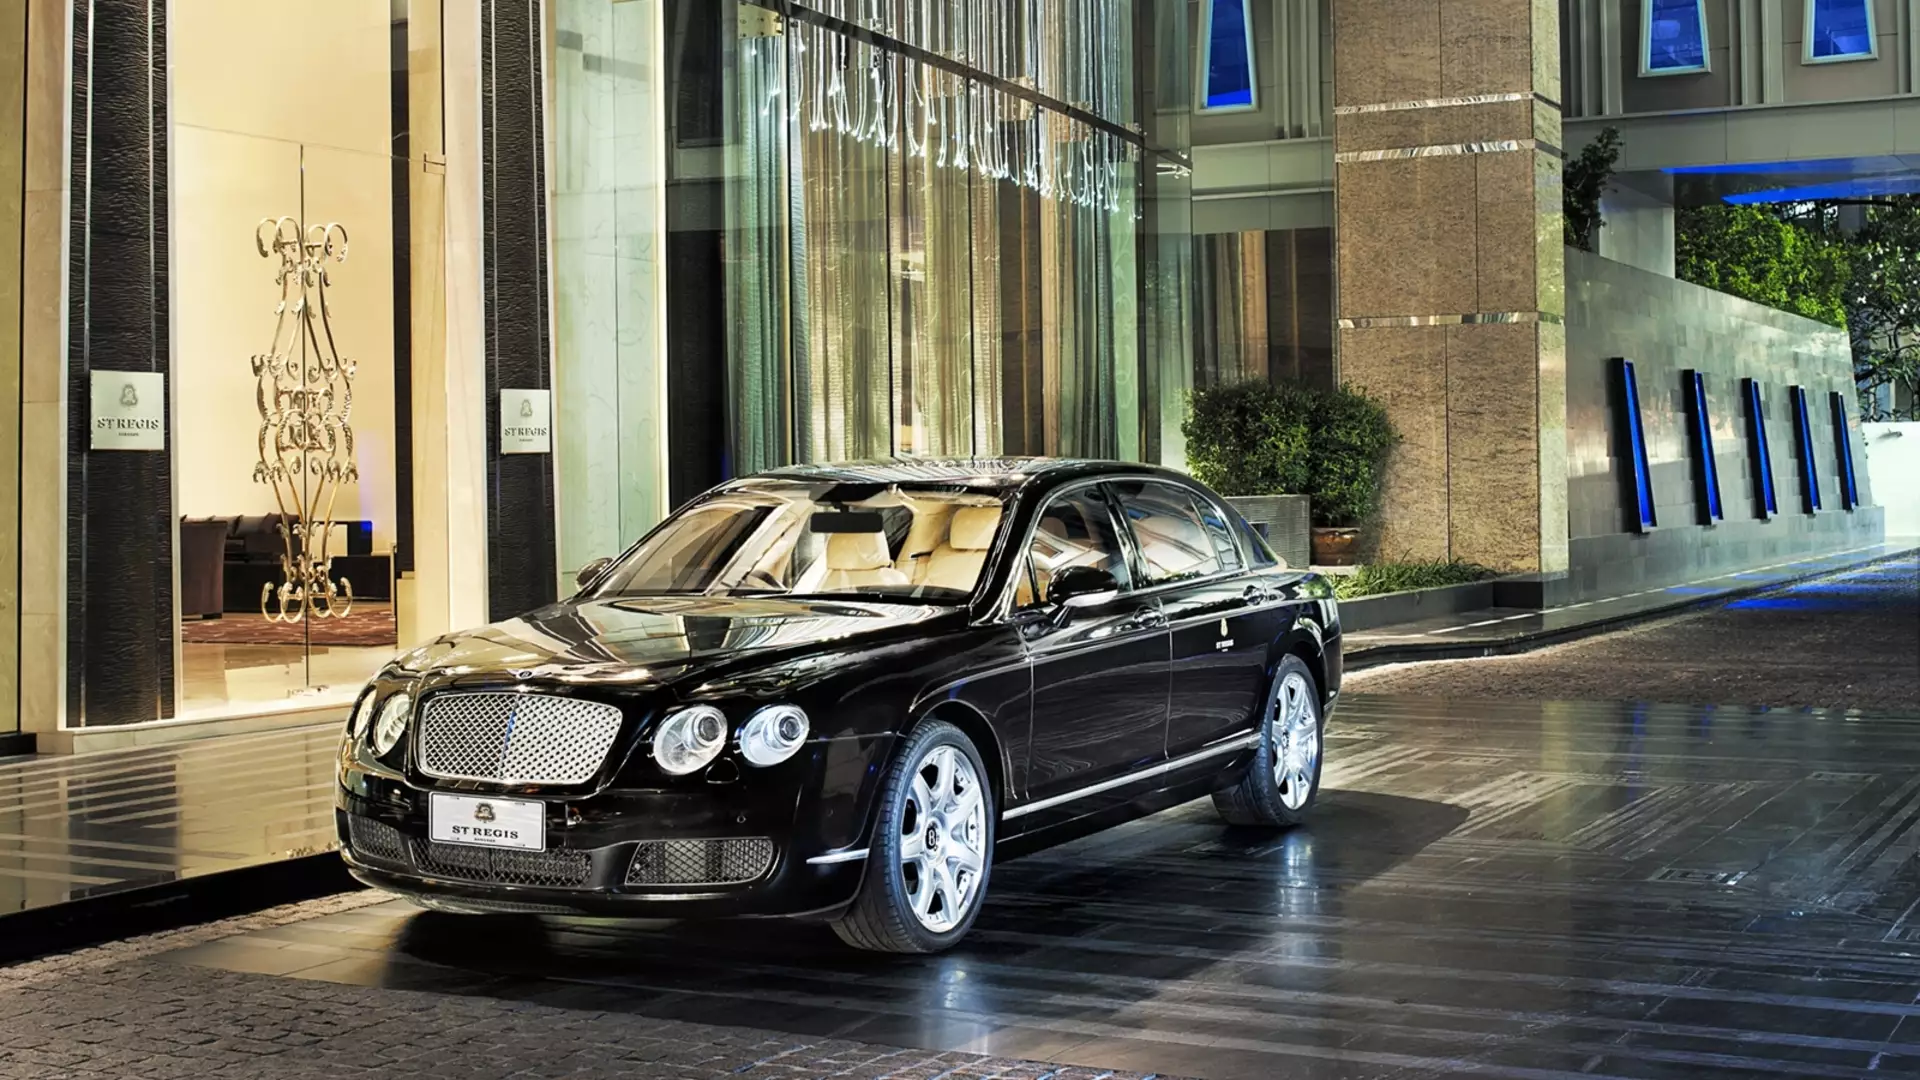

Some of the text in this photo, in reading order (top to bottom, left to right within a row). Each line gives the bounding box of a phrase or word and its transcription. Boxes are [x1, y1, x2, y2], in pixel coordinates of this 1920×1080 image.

[97, 418, 159, 430] ST REGIS
[504, 427, 547, 436] ST REGIS
[452, 825, 519, 839] ST REGIS
